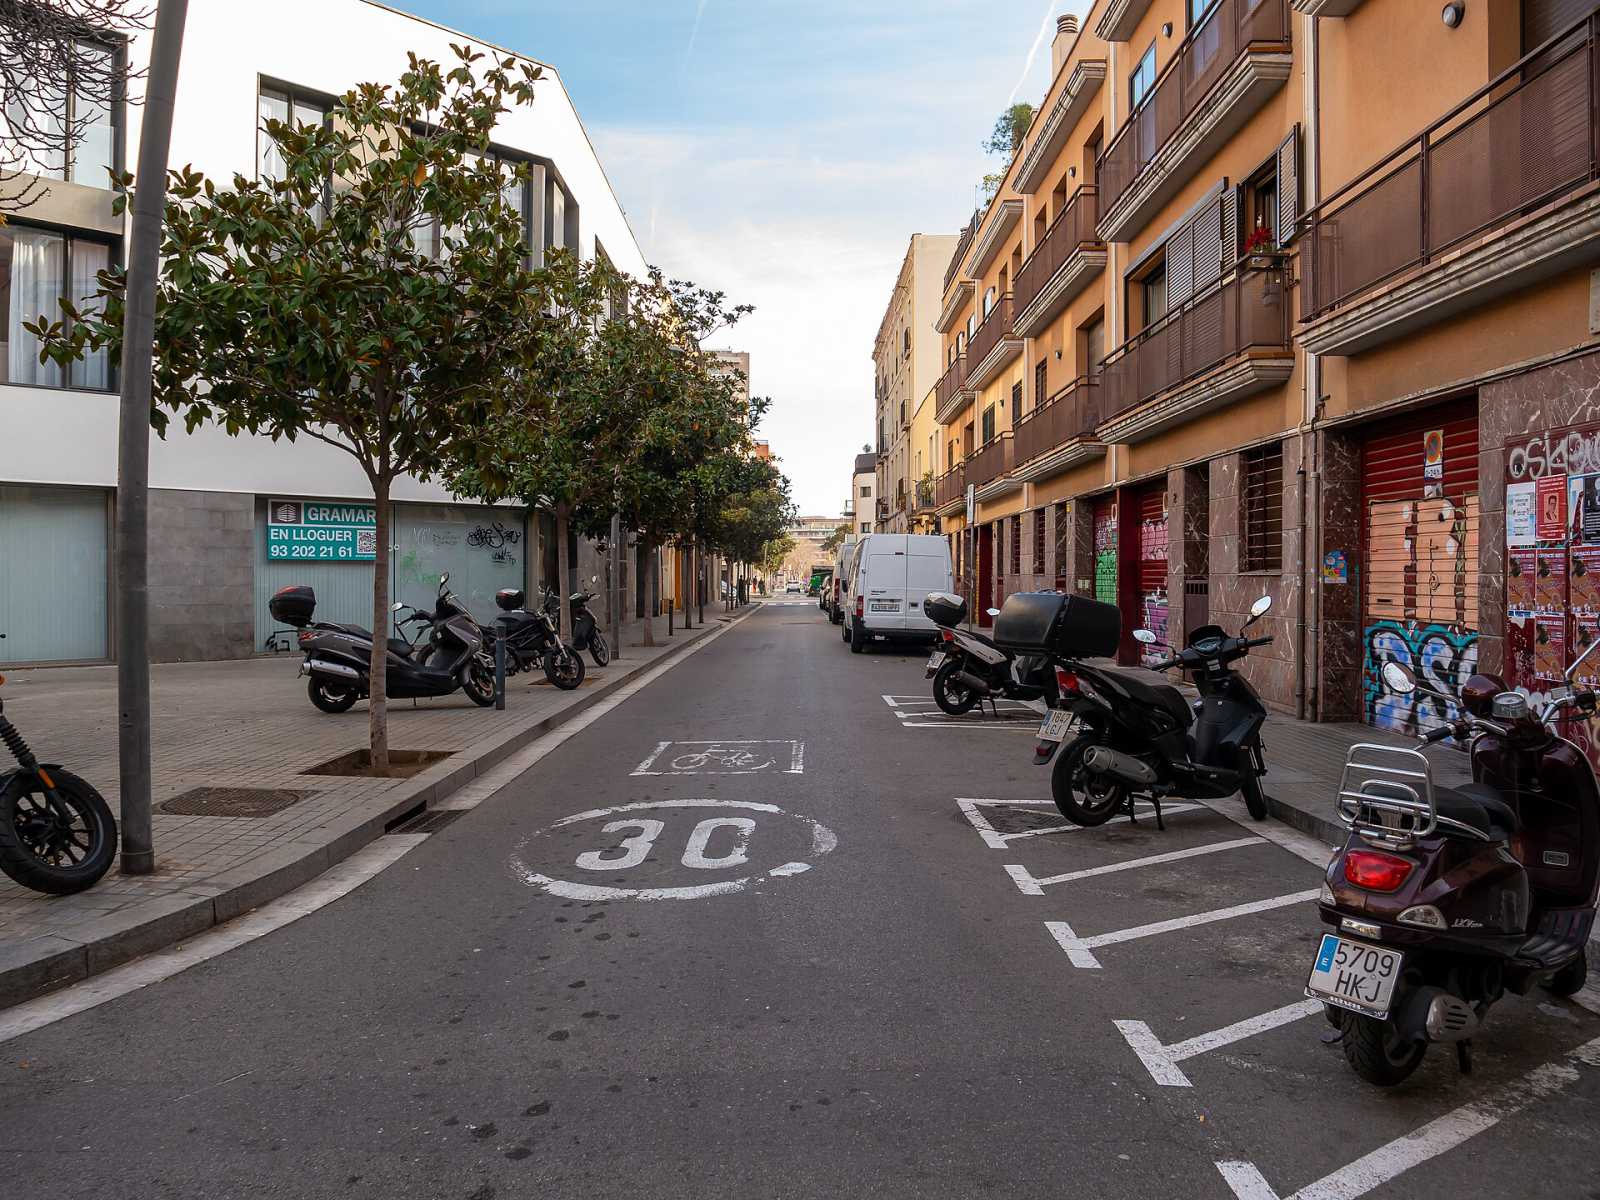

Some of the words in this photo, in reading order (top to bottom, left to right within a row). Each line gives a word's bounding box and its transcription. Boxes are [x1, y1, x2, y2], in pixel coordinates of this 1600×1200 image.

[307, 506, 376, 523] GRAMAR
[270, 528, 289, 541] EN
[292, 529, 352, 542] LLOGUER
[271, 544, 288, 557] 93
[291, 545, 316, 558] 202
[319, 546, 333, 558] 21
[338, 546, 353, 558] 61
[575, 817, 757, 871] 30
[1334, 942, 1395, 978] 5709
[1334, 969, 1382, 1003] HKJ
